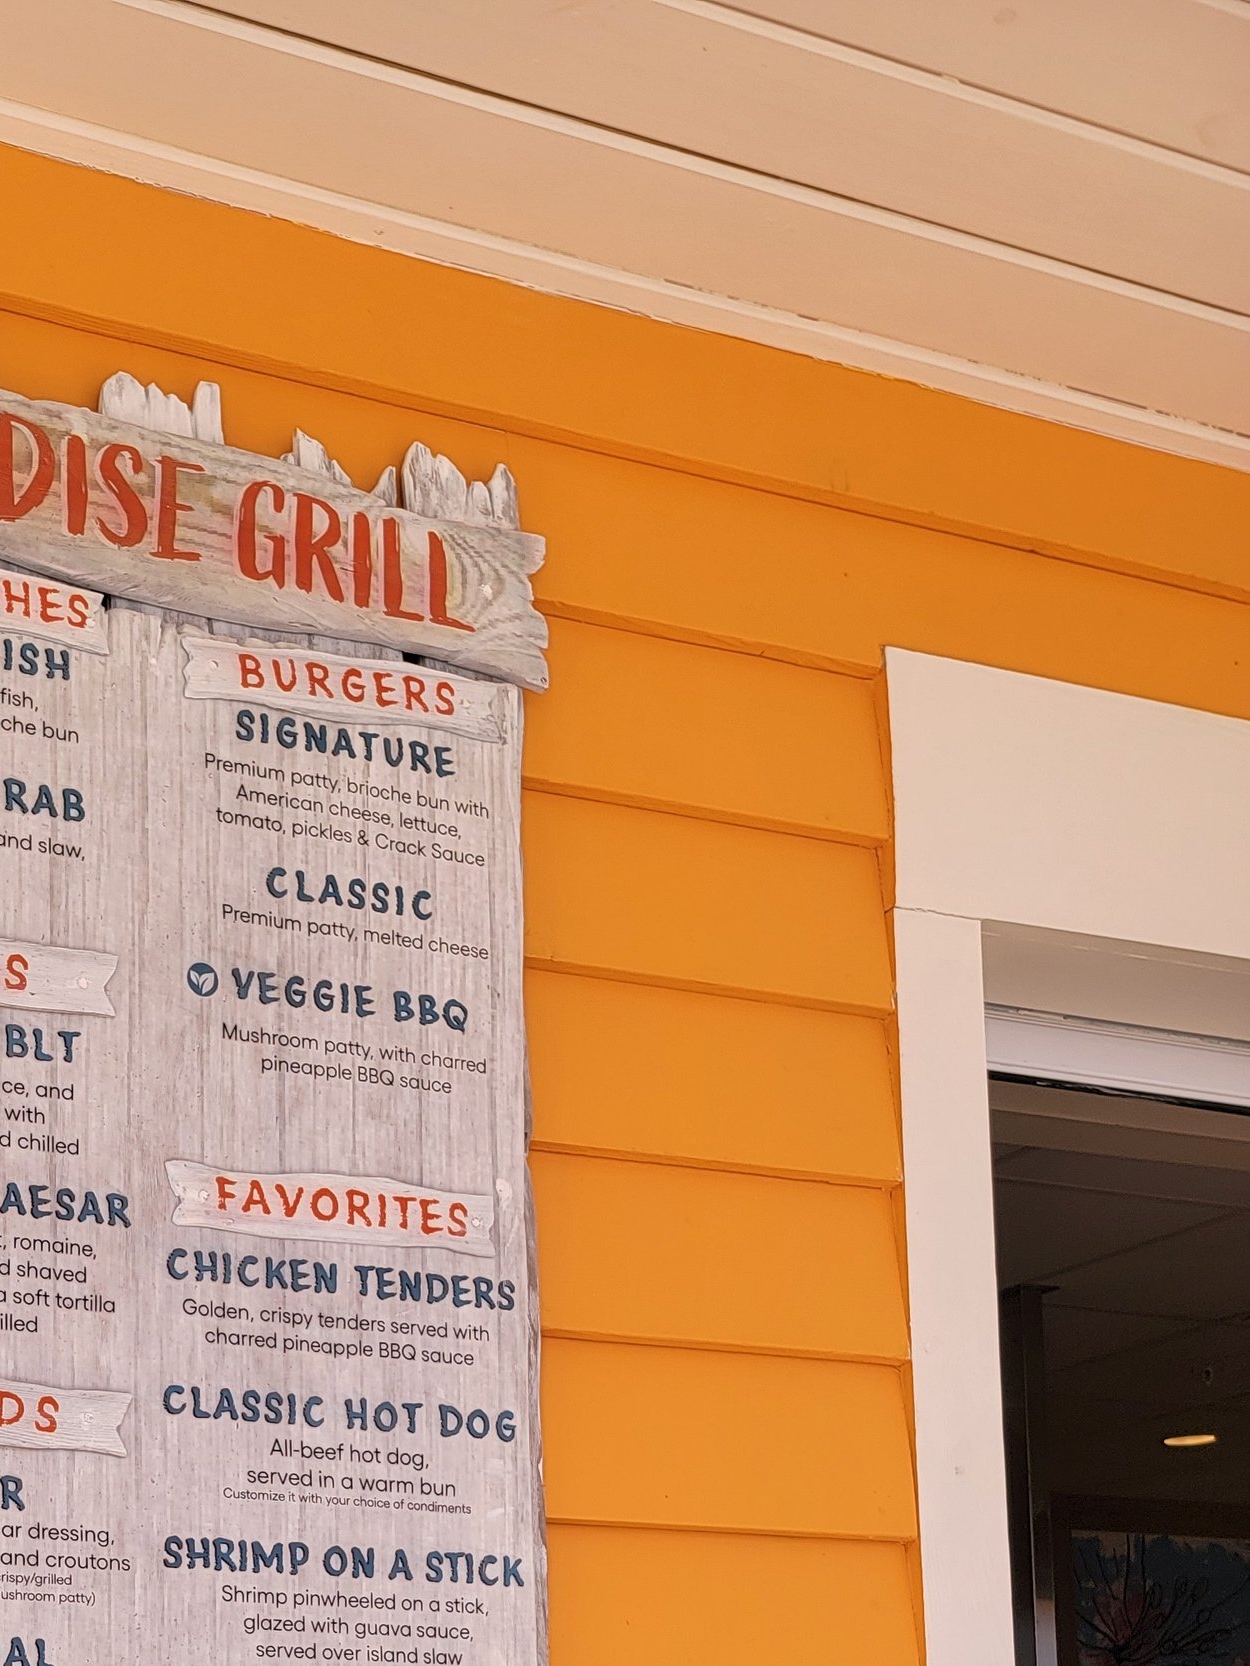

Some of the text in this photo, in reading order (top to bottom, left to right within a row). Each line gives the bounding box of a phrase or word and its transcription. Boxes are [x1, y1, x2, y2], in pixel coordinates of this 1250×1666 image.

[233, 480, 474, 632] GRILL
[0, 687, 38, 712] fish,
[237, 653, 454, 715] BURGERS
[235, 709, 455, 778] SIGNATURE
[204, 752, 489, 819] Premium patty, brioche bun with
[38, 837, 82, 858] slaw,
[215, 807, 485, 867] tomato, pickles & Crack Sauce
[265, 867, 433, 920] CLASSIC
[231, 967, 468, 1034] VEGGIE BBQ
[4, 1023, 82, 1063] BLT
[35, 1083, 74, 1101] and
[216, 1176, 467, 1236] FAVORITES
[13, 1236, 97, 1260] romaine,
[166, 1248, 515, 1311] CHICKEN TENDERS
[182, 1298, 490, 1341] Golden, crispy tenders served with
[204, 1327, 474, 1366] charred pineapple BBQ sauce
[162, 1385, 517, 1443] CLASSIC HOT DOG
[270, 1438, 429, 1471] All-beef hot dog,
[223, 1487, 472, 1514] Customize it with your choice of condiments
[0, 1549, 39, 1567] and
[45, 1554, 131, 1571] croutons
[163, 1535, 525, 1587] SHRIMP ON A STICK
[221, 1584, 489, 1617] Shrimp pinwheeled on a stick,
